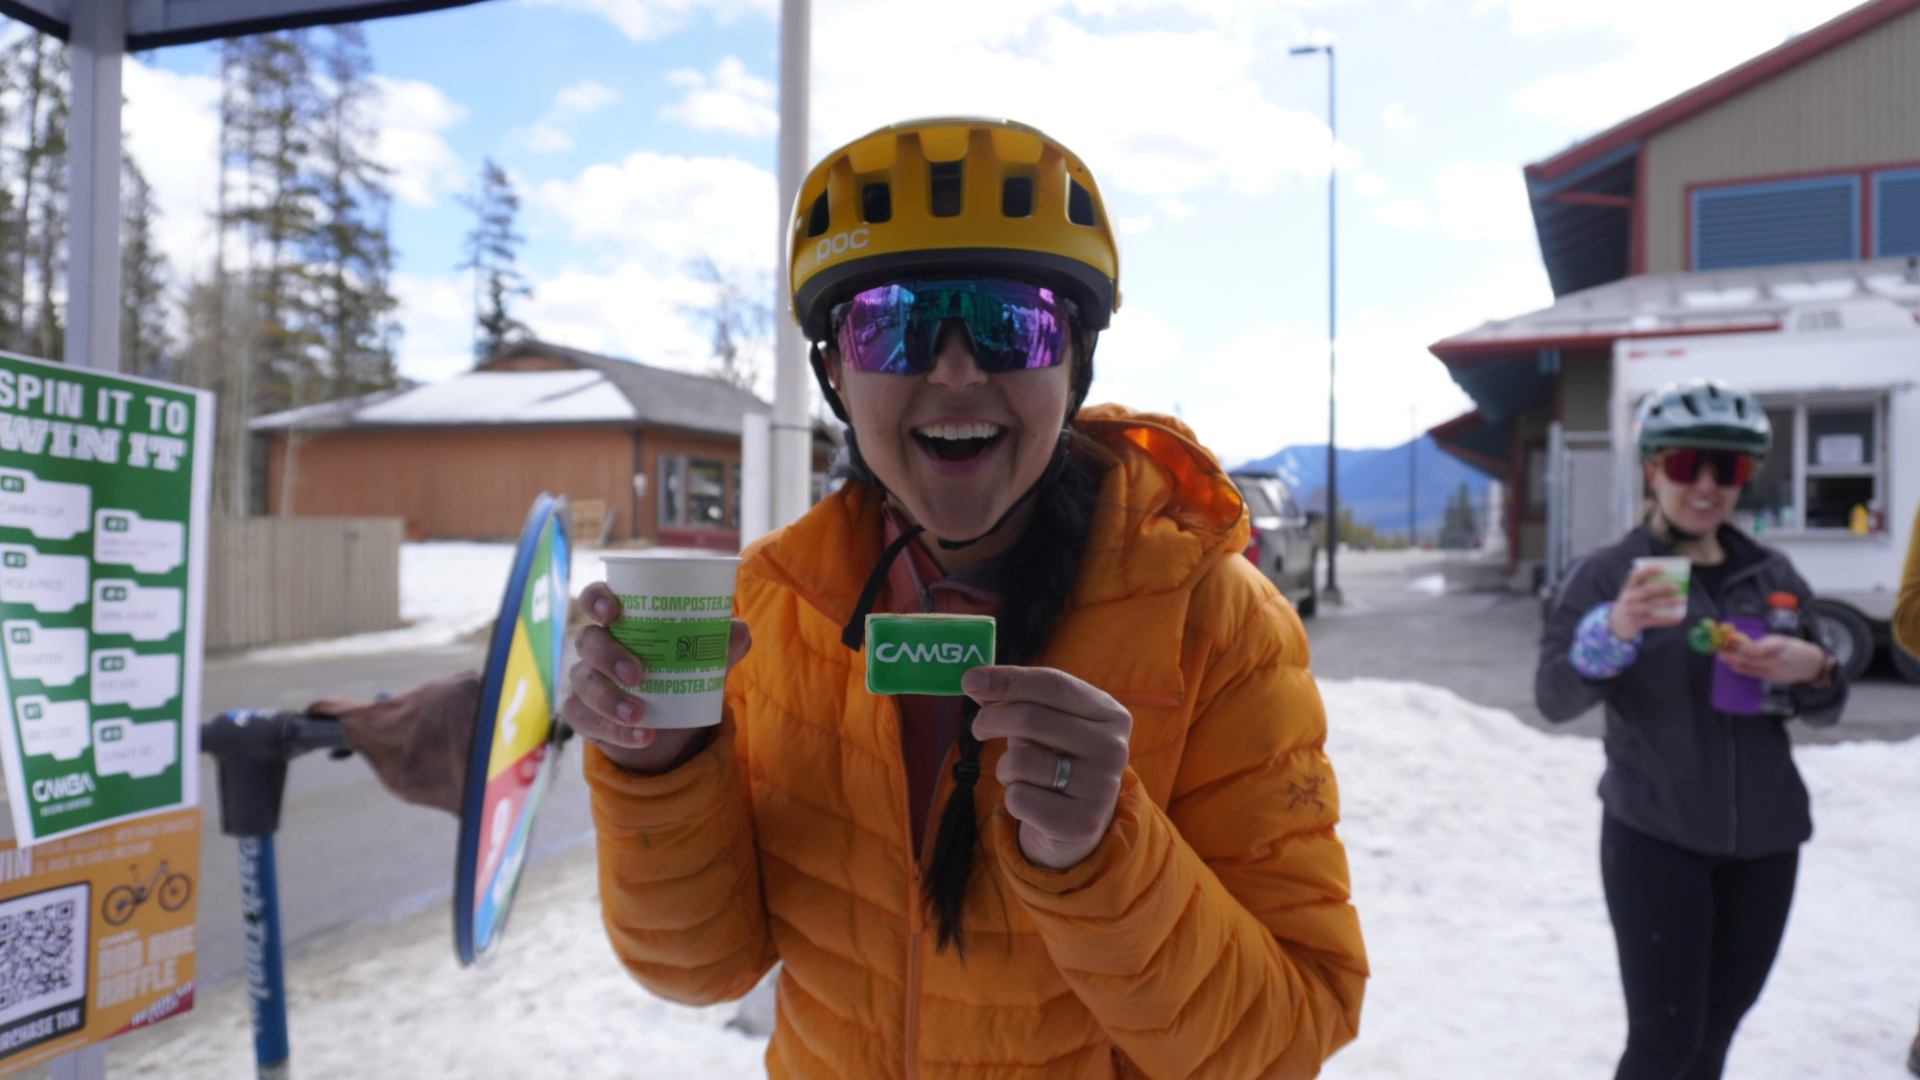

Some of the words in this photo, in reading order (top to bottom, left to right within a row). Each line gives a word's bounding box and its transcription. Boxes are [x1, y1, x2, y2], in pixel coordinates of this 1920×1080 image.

[0, 369, 83, 419] SPIN
[97, 387, 134, 425] IT
[145, 396, 189, 435] TO
[0, 411, 122, 464] WIN
[127, 431, 187, 471] IT
[875, 641, 986, 665] CAMBA
[0, 1015, 54, 1053] RCHASE
